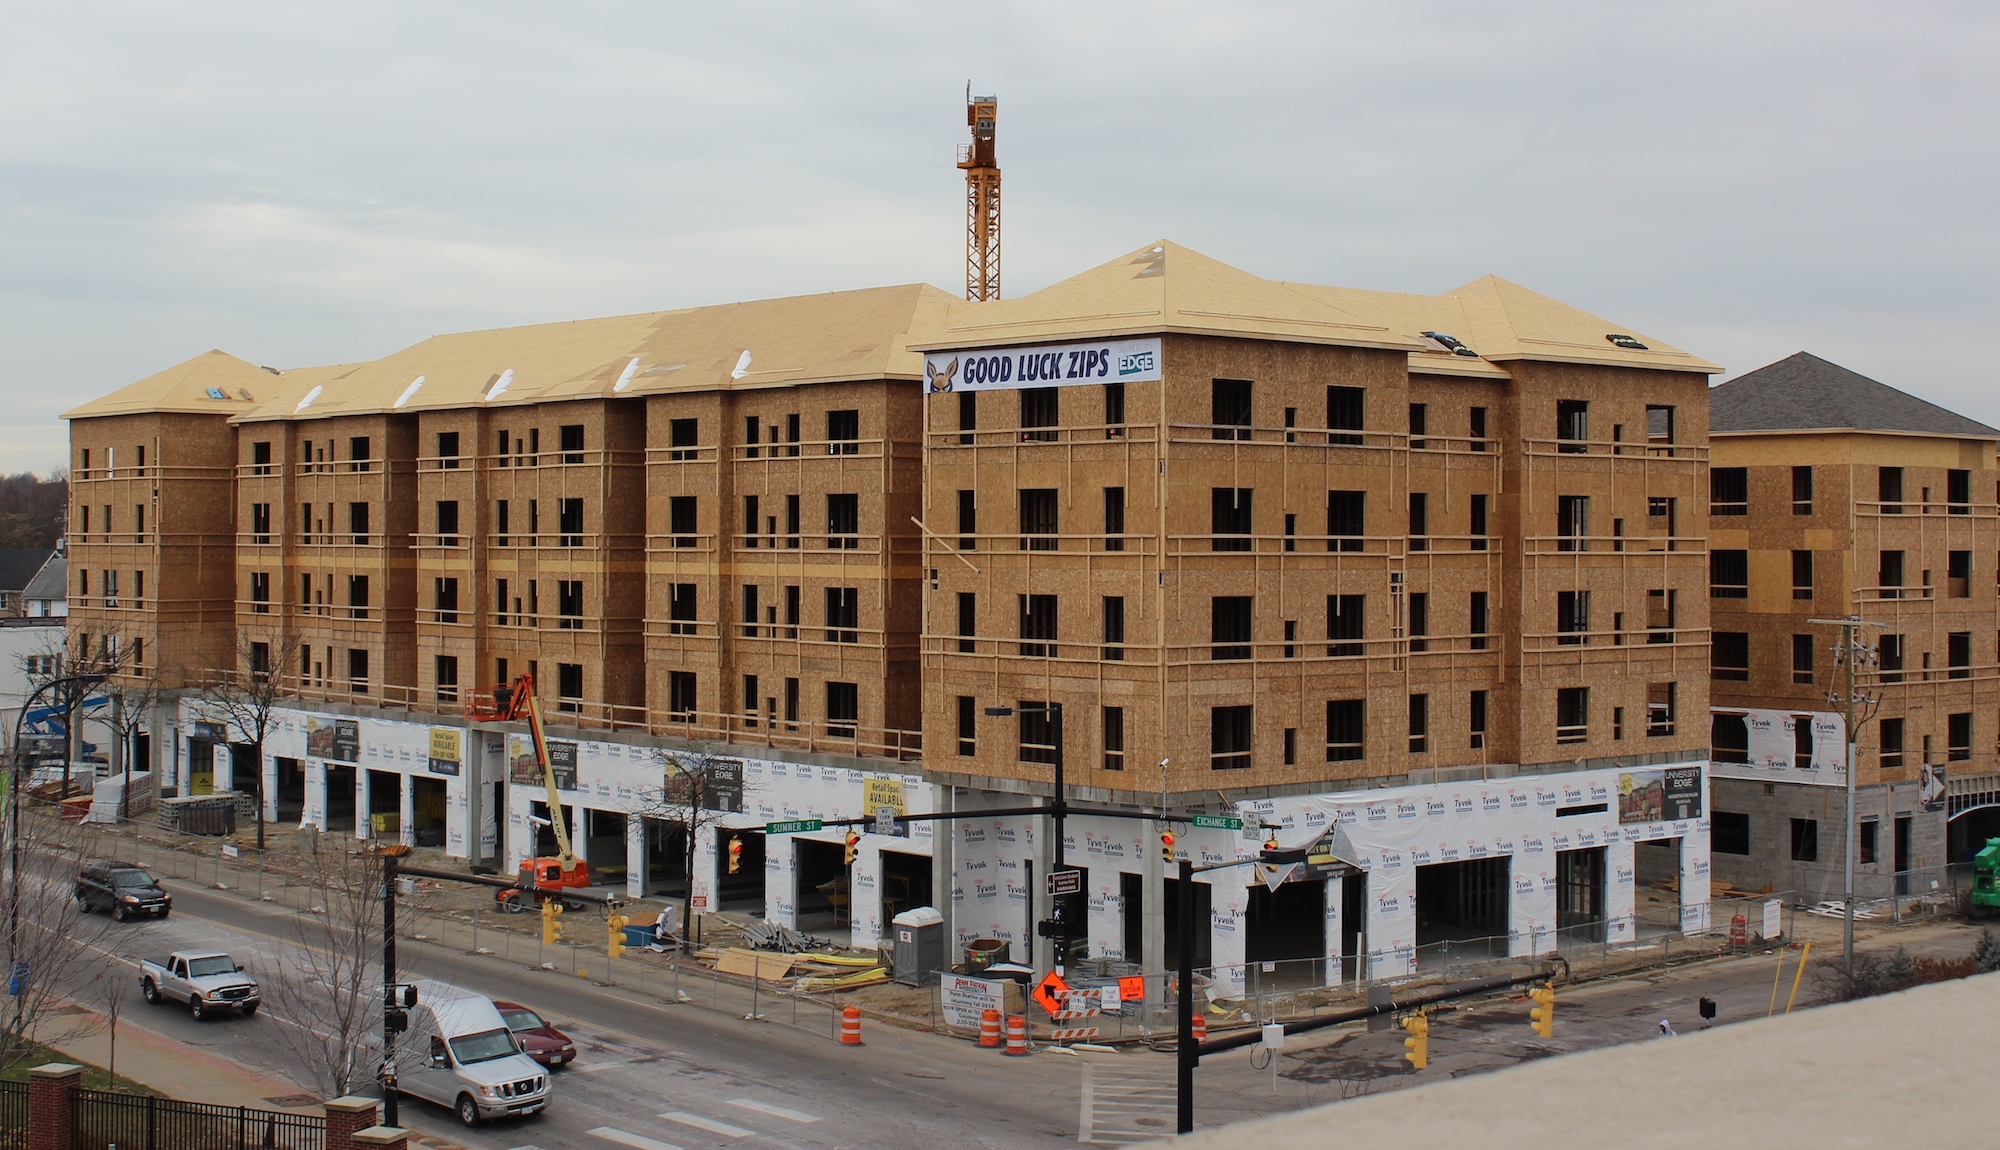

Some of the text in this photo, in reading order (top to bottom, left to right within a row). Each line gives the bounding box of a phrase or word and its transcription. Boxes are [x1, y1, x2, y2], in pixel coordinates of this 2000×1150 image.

[963, 349, 1110, 384] GOOD LUCK ZIPS
[1119, 354, 1153, 371] EDGE
[1751, 719, 1771, 728] Tyvek
[1783, 721, 1795, 729] Tyv
[1815, 723, 1836, 731] Tyvek
[341, 728, 354, 736] EDGE
[444, 733, 454, 741] Space
[433, 740, 455, 751] AVAILABLE
[607, 744, 620, 752] Tyvek
[628, 747, 642, 755] Tyvek
[553, 752, 569, 760] EDGE
[747, 760, 762, 768] Tyvek
[771, 762, 787, 770] Tyvek
[1767, 760, 1788, 768] Tyvek
[1832, 764, 1846, 772] Tyv
[796, 765, 811, 773] Tyvek
[821, 767, 837, 775] Tyvek
[715, 771, 734, 780] EDGE
[847, 770, 863, 778] Tyvek
[1665, 769, 1700, 779] UNIVERSITY
[901, 775, 918, 784] Tyvek
[1674, 779, 1692, 787] EDGE
[617, 786, 631, 794] Tyvek
[872, 783, 899, 794] Retail Spac
[1590, 787, 1607, 795] Tyvek
[1510, 794, 1527, 802] Tyvek
[1565, 789, 1581, 798] Tyvek
[1455, 799, 1472, 807] Tyvek
[1482, 796, 1500, 805] Tyvek
[759, 805, 774, 813] Tyvek
[1253, 801, 1274, 810] Tyvek
[1397, 804, 1415, 813] Tyvek
[1427, 801, 1444, 810] Tyvek
[783, 807, 799, 816] Tyvek
[808, 810, 824, 819] Tyvek
[1336, 809, 1356, 819] Tyvek
[1367, 806, 1386, 815] Tyvek
[1305, 812, 1325, 821] Tyvek
[773, 821, 815, 833] SUMNER ST
[914, 823, 932, 832] Tyvek
[1197, 818, 1239, 829] EXCHANGE ST
[1673, 822, 1688, 831] Tyvek
[964, 828, 985, 837] Tyvek
[996, 827, 1015, 836] Tyvek
[1624, 828, 1640, 836] Tyvek
[1648, 825, 1664, 833] Tyvek
[450, 831, 462, 839] Tyvek
[1578, 833, 1595, 842] Tyvek
[1603, 830, 1619, 839] Tyvek
[1062, 836, 1075, 844] vek
[1087, 838, 1102, 848] Tyve
[1552, 836, 1569, 845] Tyvek
[706, 842, 716, 850] Tyv
[1104, 841, 1123, 850] Tyvek
[1469, 845, 1487, 853] Tyvek
[1496, 842, 1513, 850] Tyvek
[1173, 850, 1189, 858] yvek
[1411, 851, 1430, 860] Tyvek
[1441, 847, 1459, 856] Tyvek
[1201, 852, 1223, 862] Tyvek
[1359, 857, 1371, 865] vek
[1382, 854, 1400, 863] Tyvek
[966, 861, 987, 870] Tyvek
[1694, 861, 1708, 870] Tyvek
[857, 873, 874, 883] Tyvek
[1617, 869, 1633, 878] Tyvek
[976, 884, 996, 892] Tyvek
[1516, 880, 1533, 889] Tyvek
[1007, 885, 1027, 894] Tyvek
[776, 901, 793, 911] Tyvek
[1379, 898, 1398, 907] Tyvek
[1231, 909, 1246, 918] Tyv
[1682, 906, 1698, 916] Tyvek
[870, 921, 880, 929] Tyv
[1214, 916, 1235, 925] Tyvek
[959, 932, 980, 941] Tyvek
[992, 929, 1012, 939] Tyvek
[1101, 947, 1122, 956] Tyvek
[1231, 968, 1246, 977] Tyv
[955, 978, 968, 989] PENN
[970, 980, 987, 993] STATION
[962, 992, 978, 1000] Station
